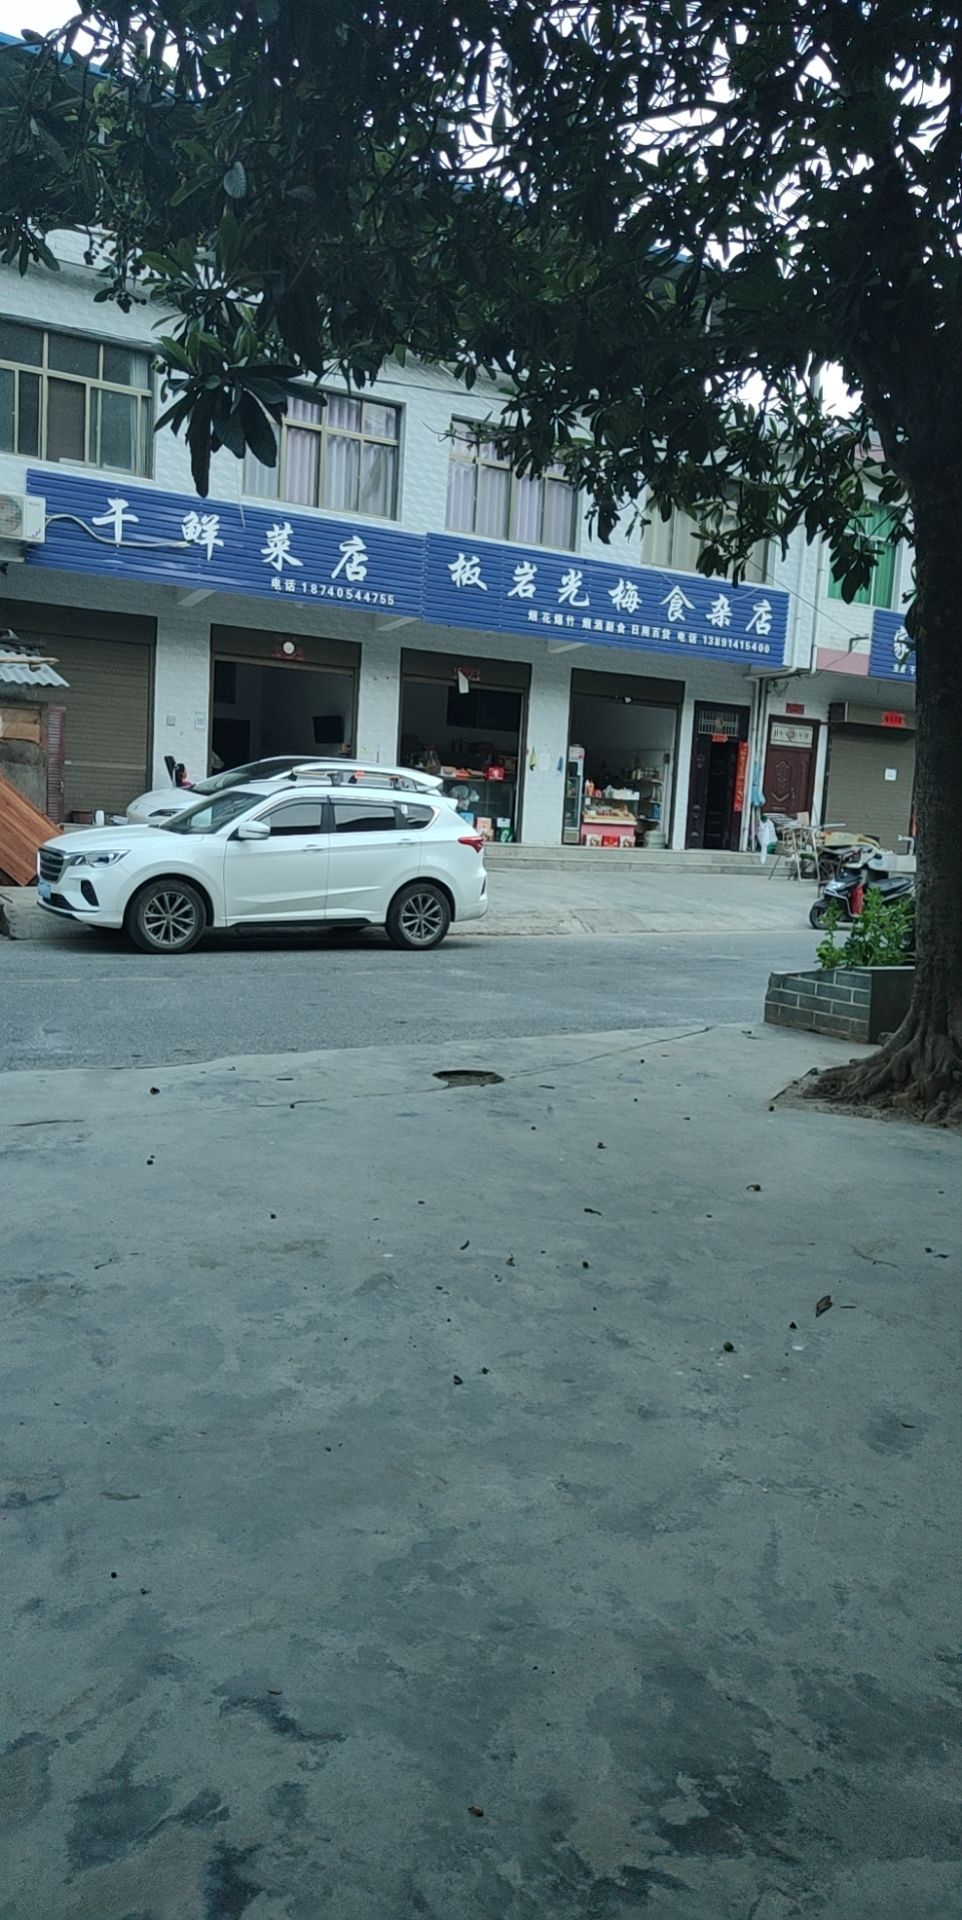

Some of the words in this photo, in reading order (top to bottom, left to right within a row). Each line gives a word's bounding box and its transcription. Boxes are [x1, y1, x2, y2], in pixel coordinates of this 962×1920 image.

[92, 498, 369, 582] 干鲜菜店
[271, 576, 296, 592] 电话
[301, 582, 395, 606] 18740544755
[448, 553, 774, 636] 板岩光梅食杂店
[528, 609, 576, 627] 烟花爆竹
[631, 624, 672, 640] 日用百货
[677, 631, 698, 644] 电话
[703, 635, 770, 654] 13891415400
